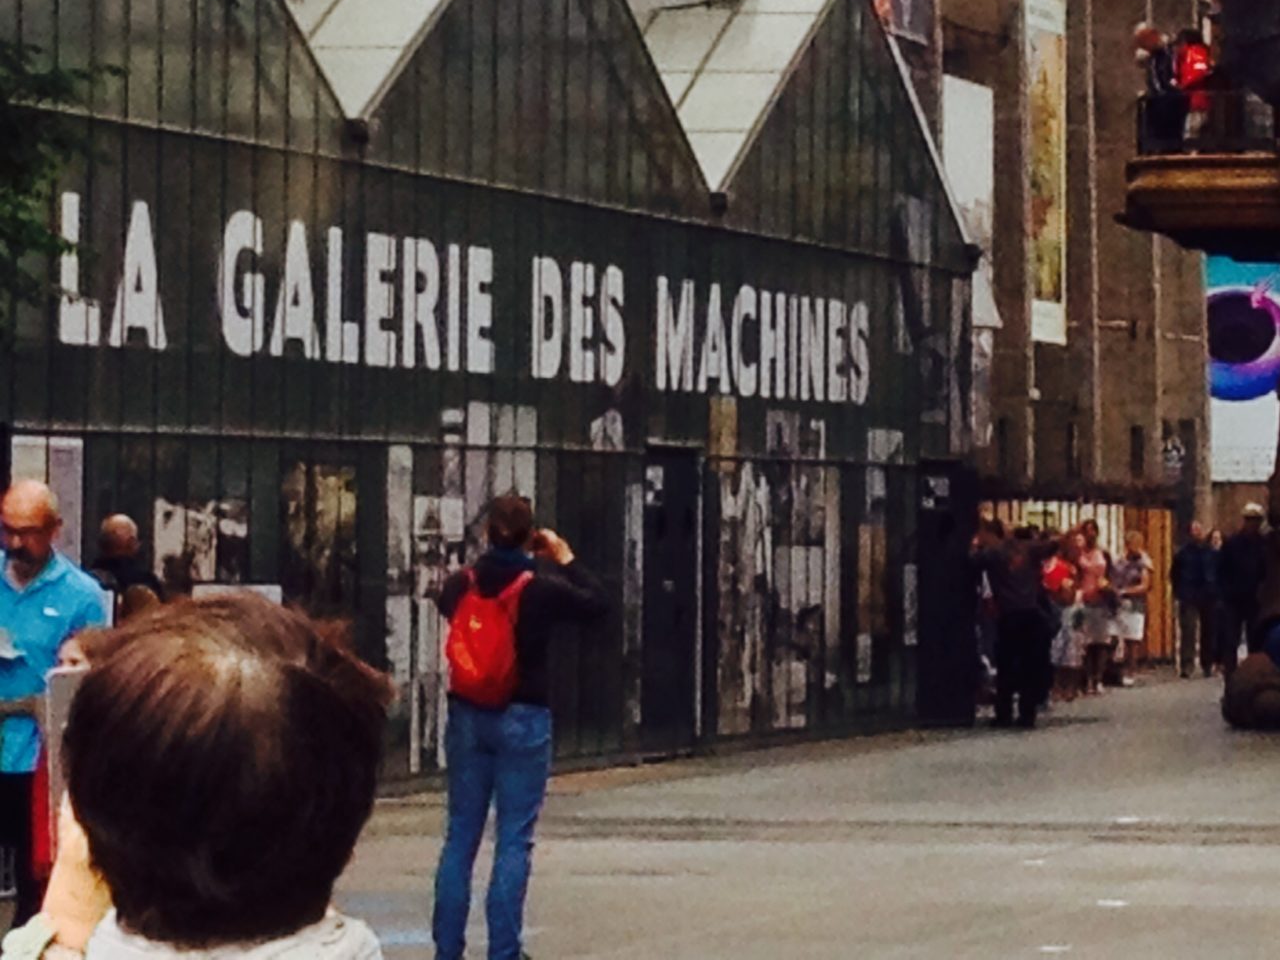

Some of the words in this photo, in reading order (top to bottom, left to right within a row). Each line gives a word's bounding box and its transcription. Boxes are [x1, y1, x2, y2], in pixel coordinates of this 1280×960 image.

[60, 191, 167, 350] LA
[218, 210, 495, 373] GALERIE
[531, 256, 625, 387] DES
[656, 275, 870, 406] MACHINES
